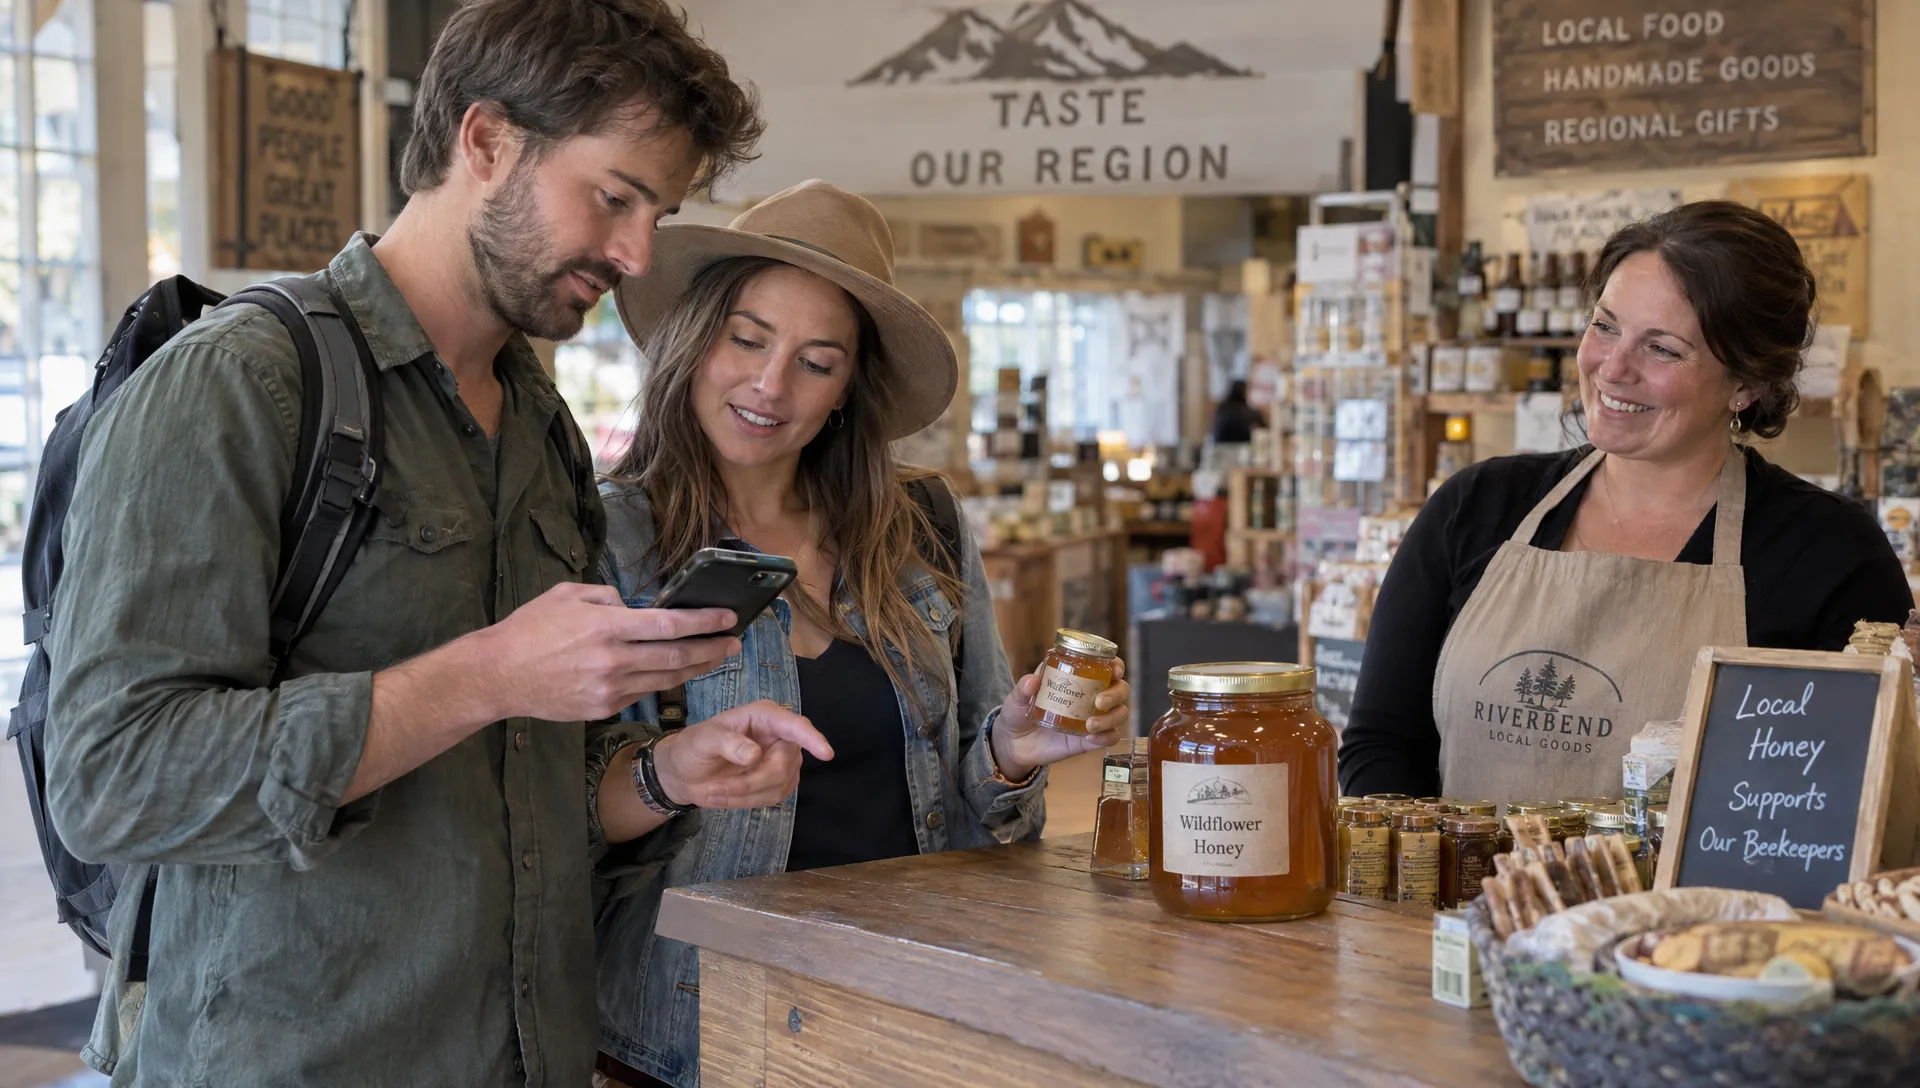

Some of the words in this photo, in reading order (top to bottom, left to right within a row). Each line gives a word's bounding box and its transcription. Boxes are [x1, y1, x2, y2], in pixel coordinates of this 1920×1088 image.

[1542, 16, 1631, 46] LOCAL
[1642, 10, 1725, 39] FOOD
[1543, 58, 1703, 92] HANDMADE
[1719, 52, 1816, 82] GOODS
[991, 88, 1146, 128] TASTE
[1544, 113, 1683, 146] REGIONAL
[1695, 105, 1780, 136] GIFTS
[909, 150, 1004, 188] OUR
[1034, 144, 1229, 185] REGION
[1474, 701, 1613, 738] RIVERBEND
[1735, 681, 1815, 720] Local
[1489, 729, 1532, 747] LOCAL
[1539, 738, 1592, 754] GOODS
[1748, 727, 1826, 776] Honey
[1728, 780, 1827, 820] Supports
[1180, 814, 1262, 832] Wildflower
[1194, 838, 1245, 860] Honey
[1699, 826, 1737, 852] Our
[1743, 828, 1846, 873] Beekeepers
